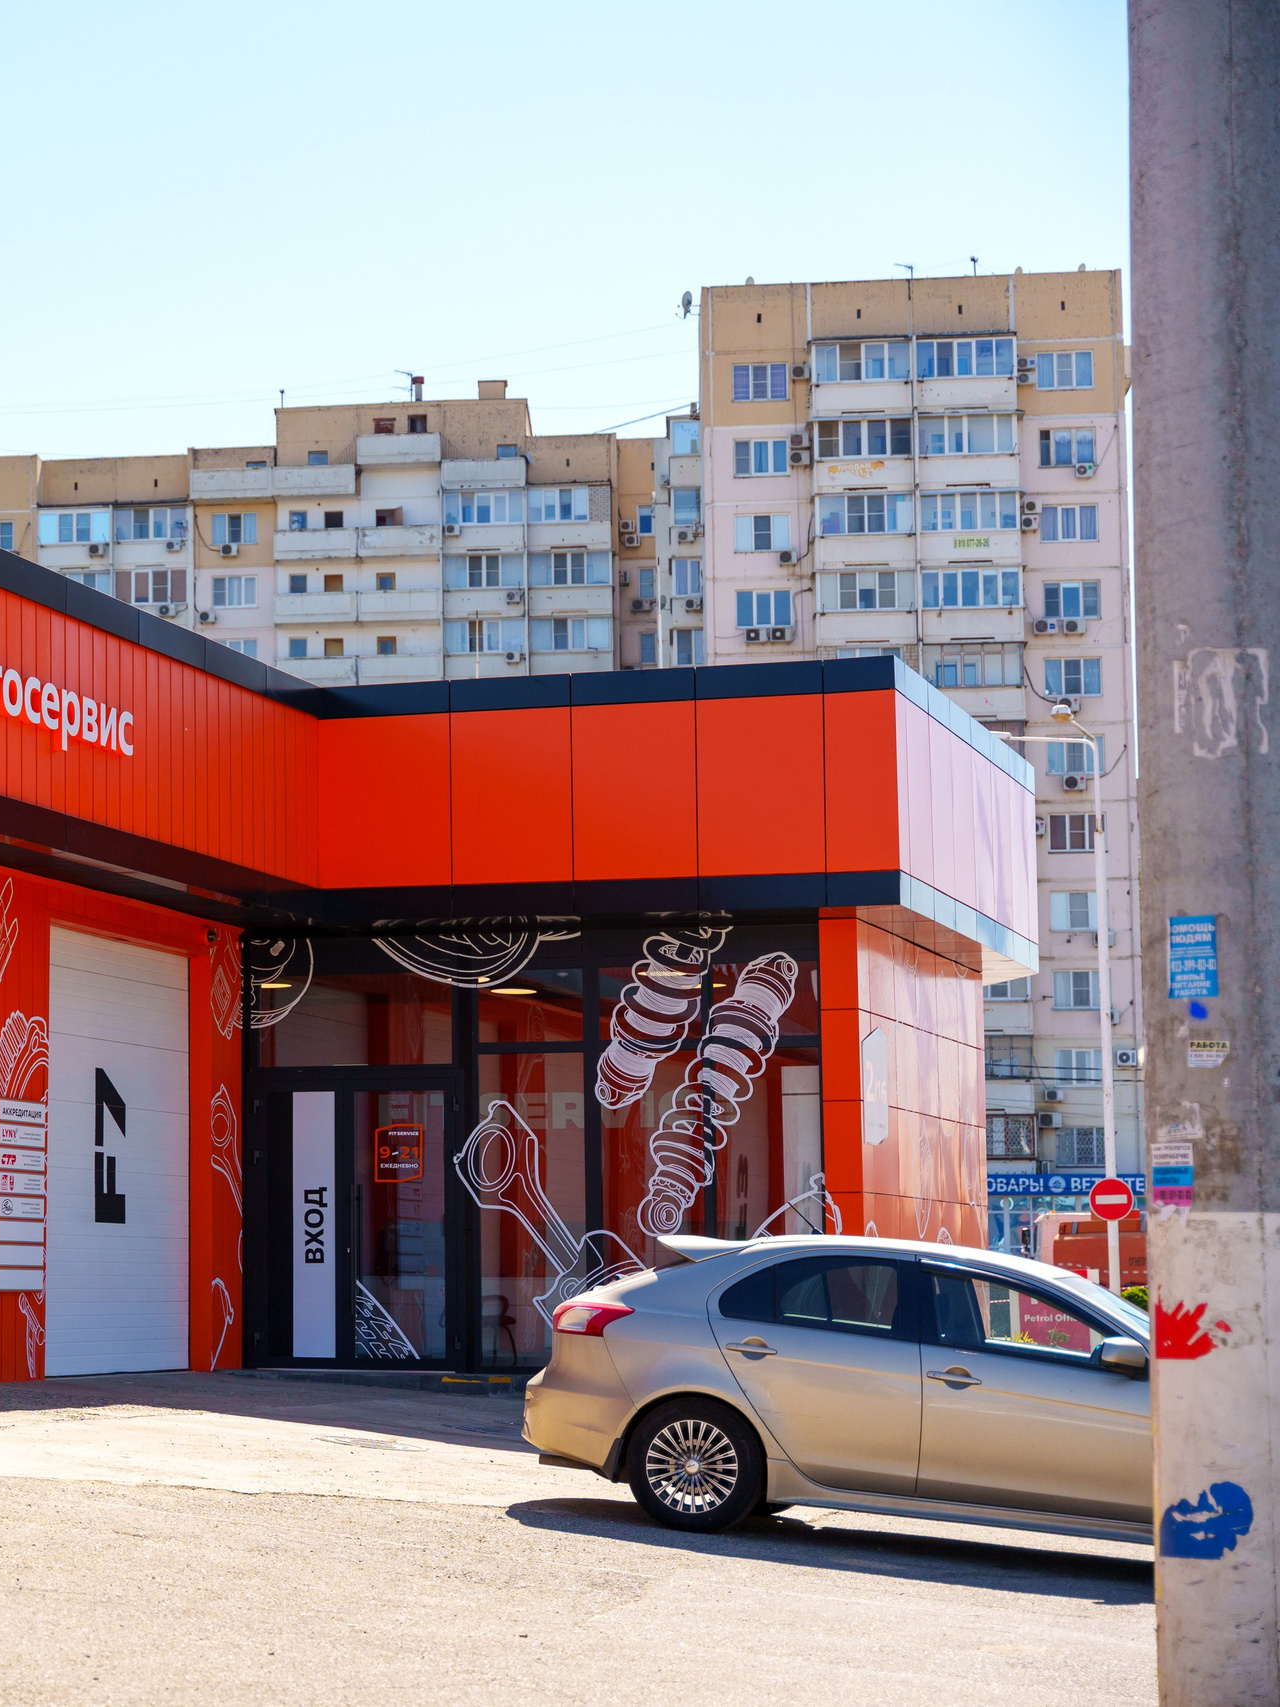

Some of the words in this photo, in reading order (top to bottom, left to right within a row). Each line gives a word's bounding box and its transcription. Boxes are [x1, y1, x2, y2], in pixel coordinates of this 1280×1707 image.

[1171, 923, 1215, 934] ОМОЩЬ
[1190, 1041, 1228, 1049] РАБОТА
[2, 1107, 42, 1119] АККРЕДИТАЦИЯ
[94, 1067, 127, 1224] F7
[987, 1177, 1044, 1192] ОВАРЫ
[304, 1187, 328, 1264] ВХОД
[1024, 1314, 1053, 1322] Petrol
